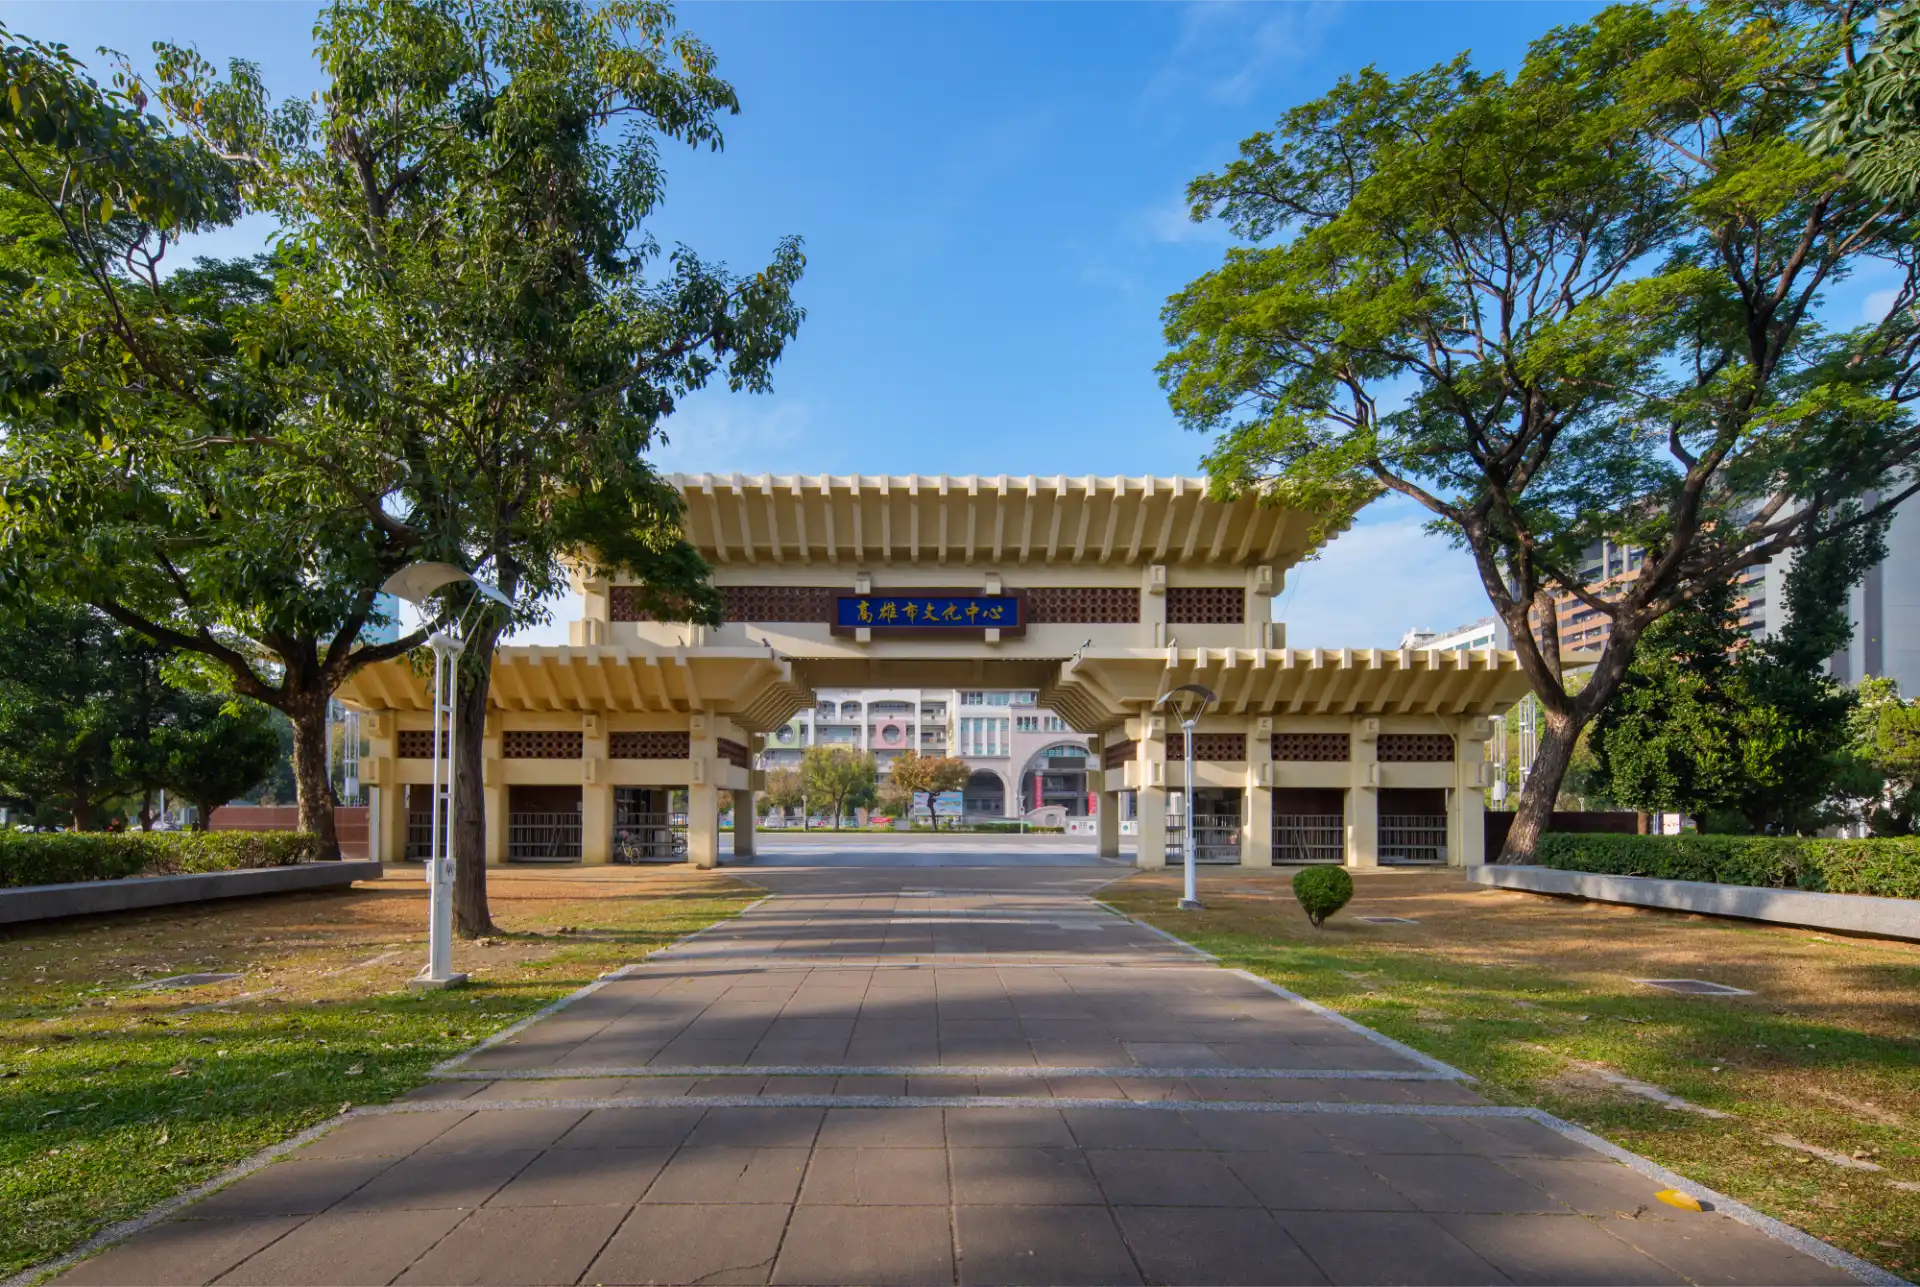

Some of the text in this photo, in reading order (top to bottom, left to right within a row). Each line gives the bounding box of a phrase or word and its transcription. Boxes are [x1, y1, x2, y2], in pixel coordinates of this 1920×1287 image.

[856, 599, 1004, 624] 高雄市文化中心
